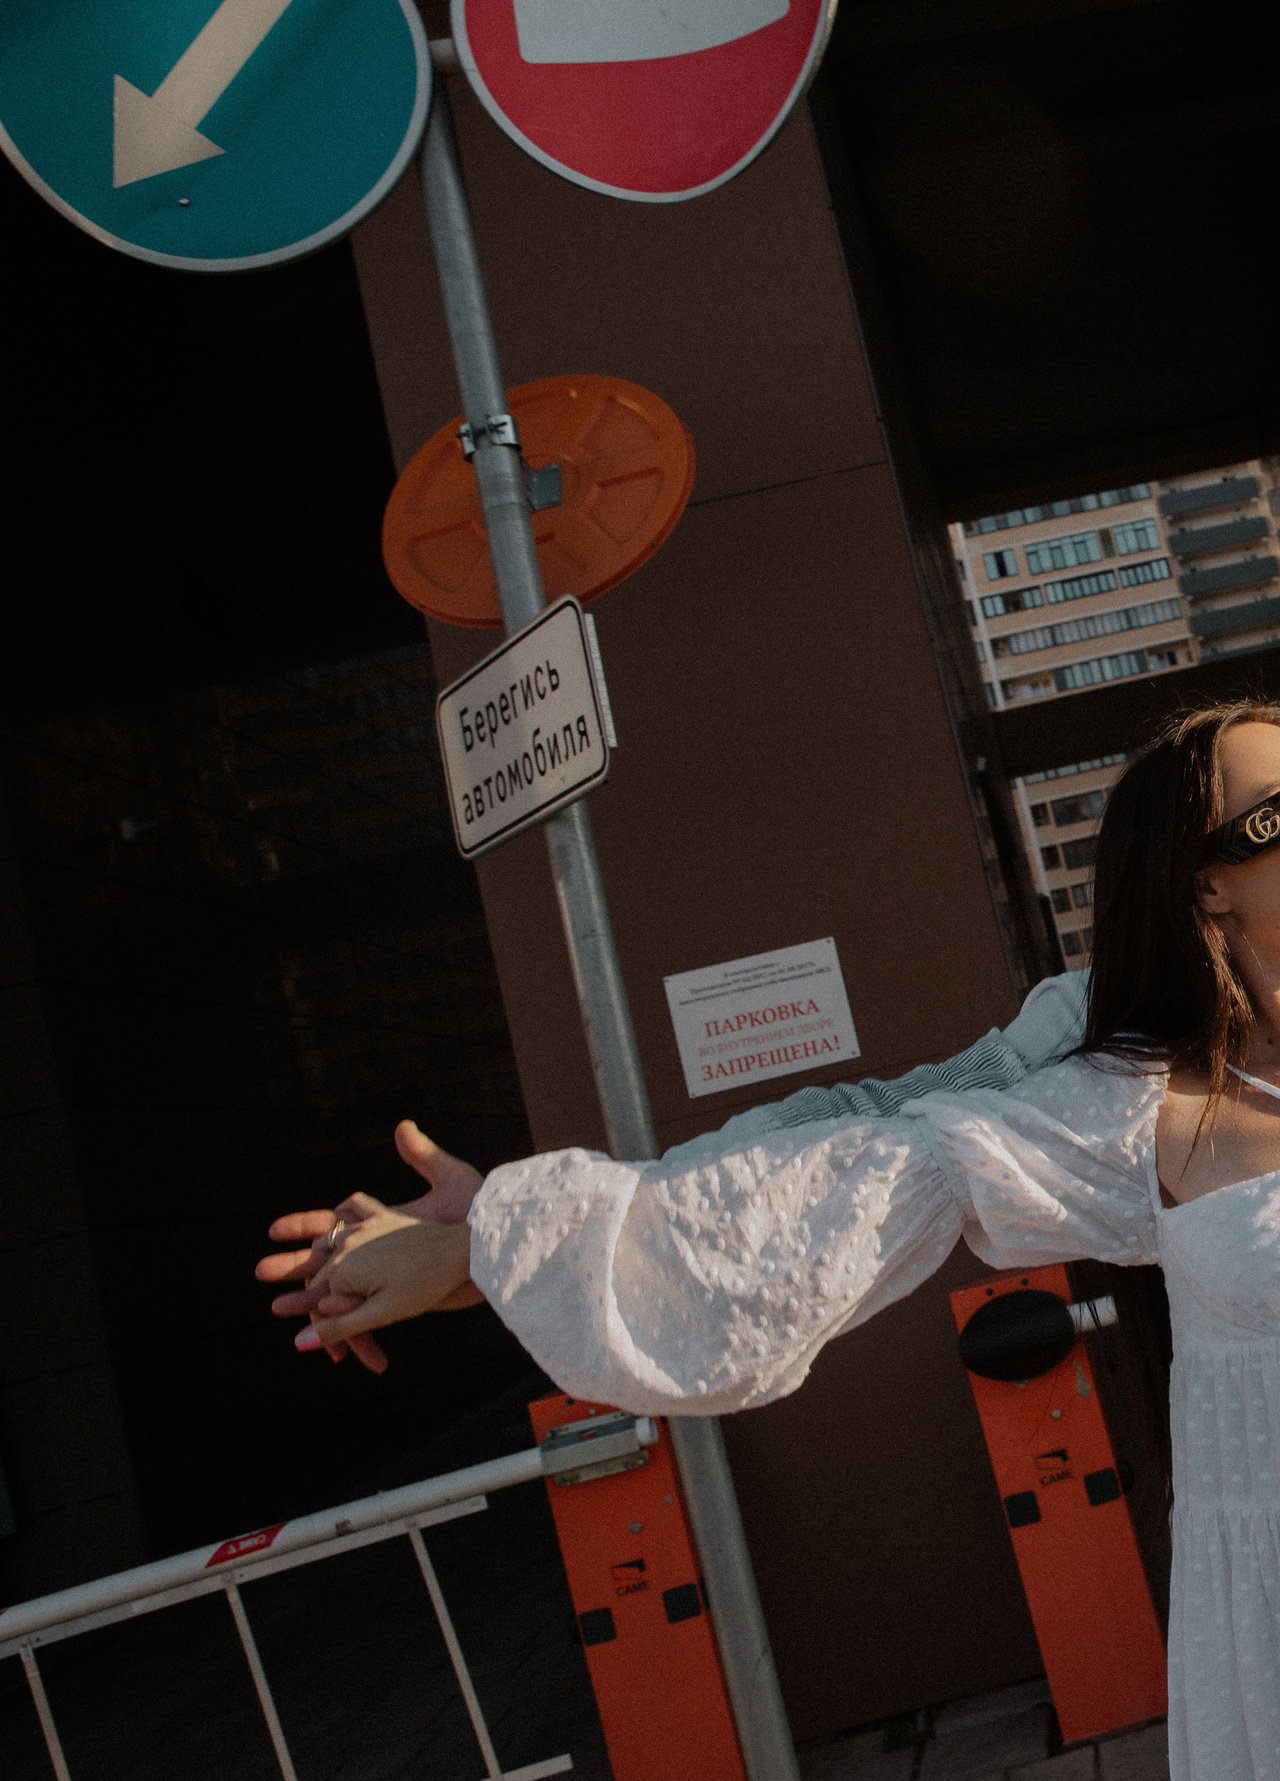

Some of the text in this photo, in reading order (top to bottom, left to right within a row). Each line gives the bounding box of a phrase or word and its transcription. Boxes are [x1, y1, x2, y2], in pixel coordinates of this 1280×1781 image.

[458, 659, 561, 753] Берегись
[462, 714, 591, 826] автомобиля
[704, 998, 820, 1038] ПАРКОВКА
[702, 1035, 841, 1083] ЗАПРЕЩЕНА!
